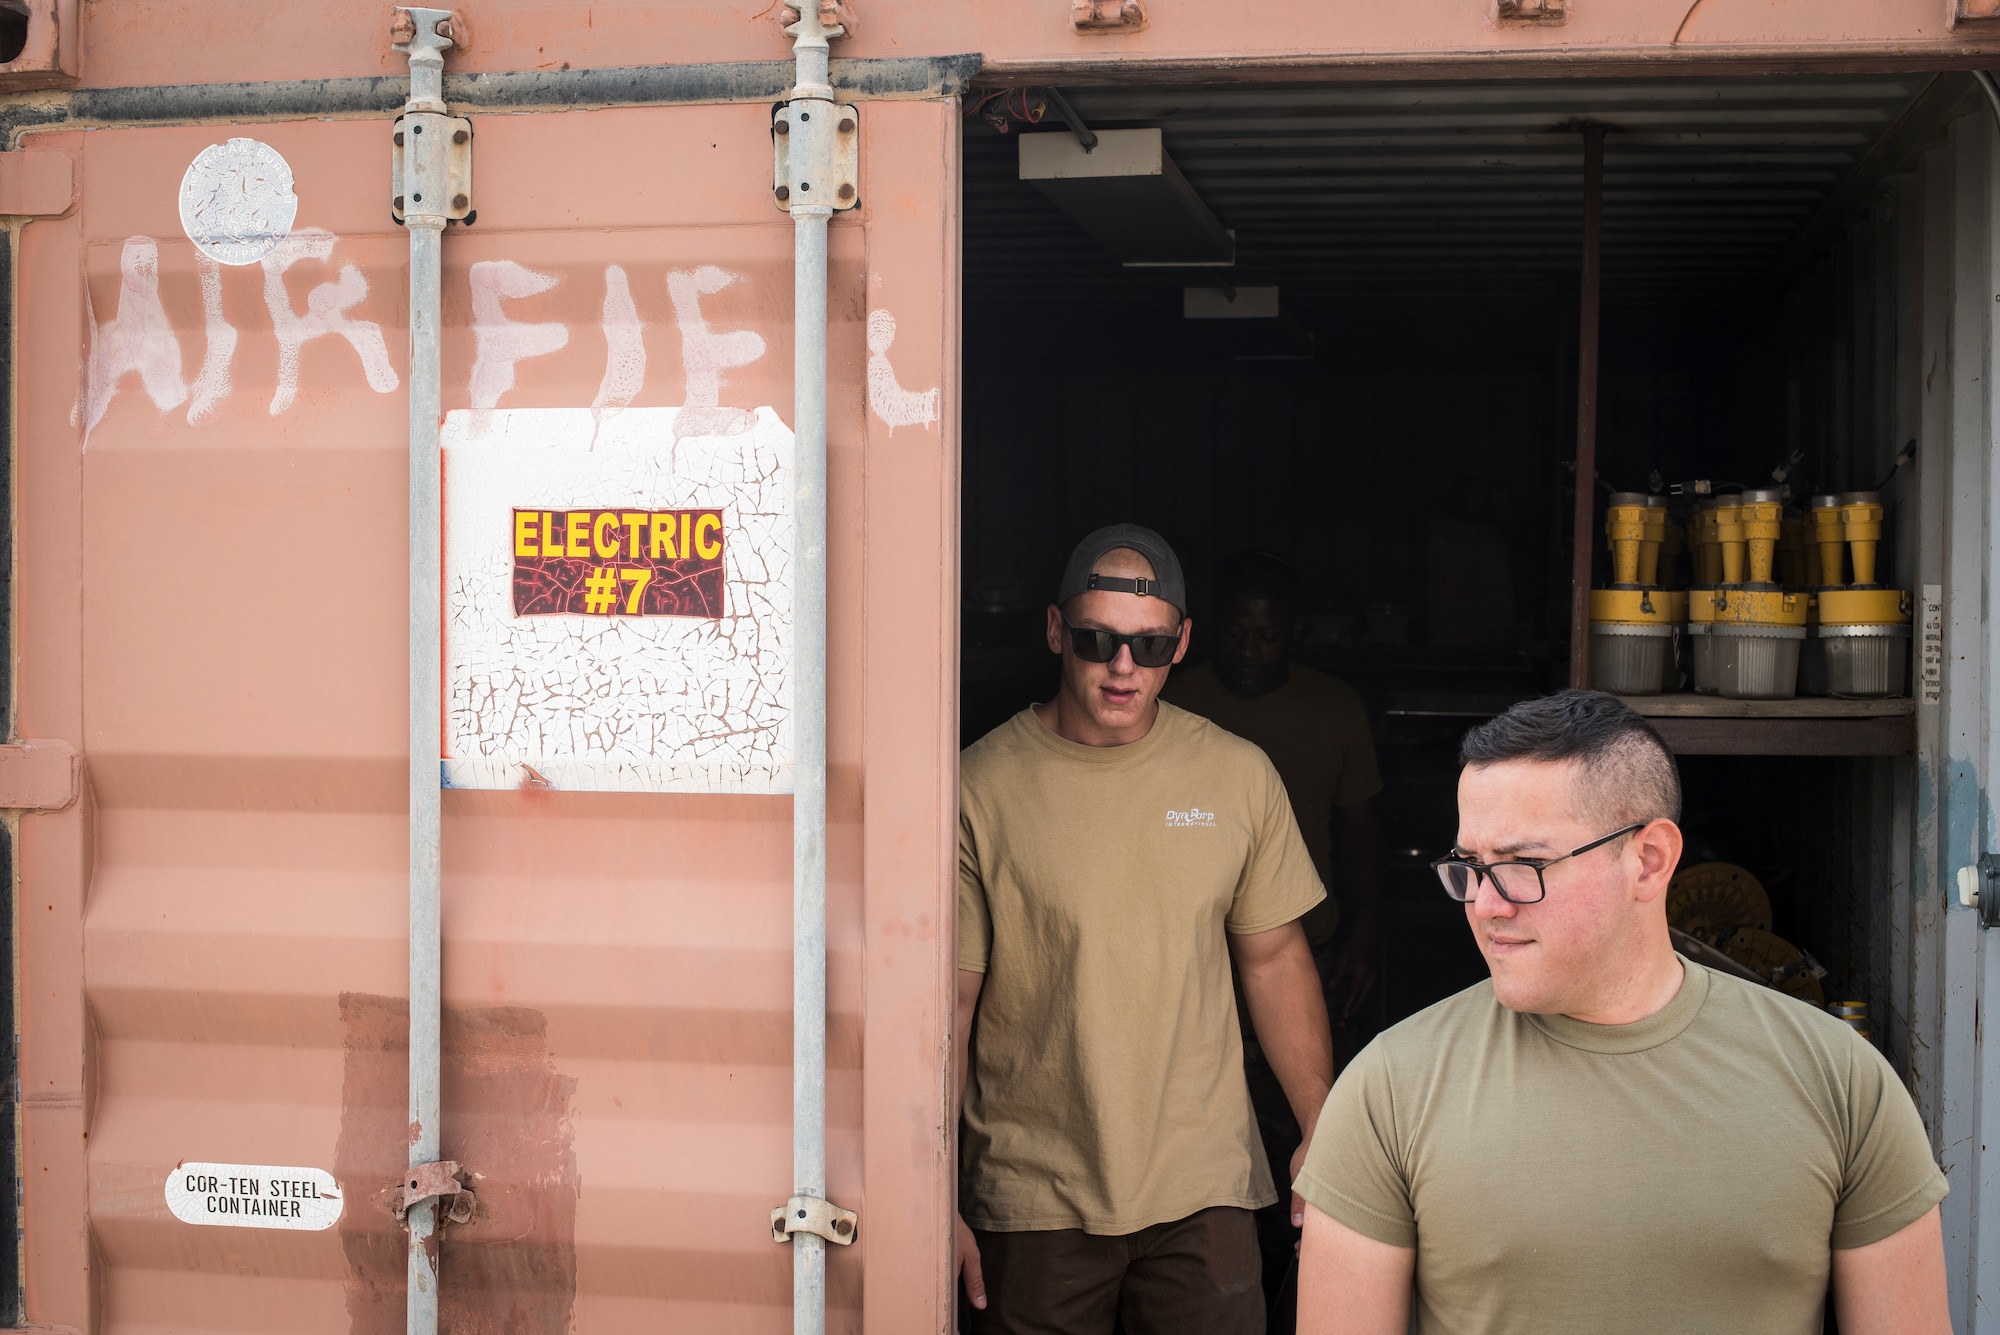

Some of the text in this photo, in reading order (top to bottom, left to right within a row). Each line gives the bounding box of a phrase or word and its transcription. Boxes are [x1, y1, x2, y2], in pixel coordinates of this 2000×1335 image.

[186, 143, 293, 204] AMERICAN BUREAU
[193, 226, 282, 259] OF SHIPPING
[74, 228, 400, 432] AIR
[514, 511, 722, 560] ELECTRIC
[584, 567, 652, 614] #7
[186, 1174, 321, 1199] COR-TEN STEEL
[206, 1196, 302, 1218] CONTAINER
